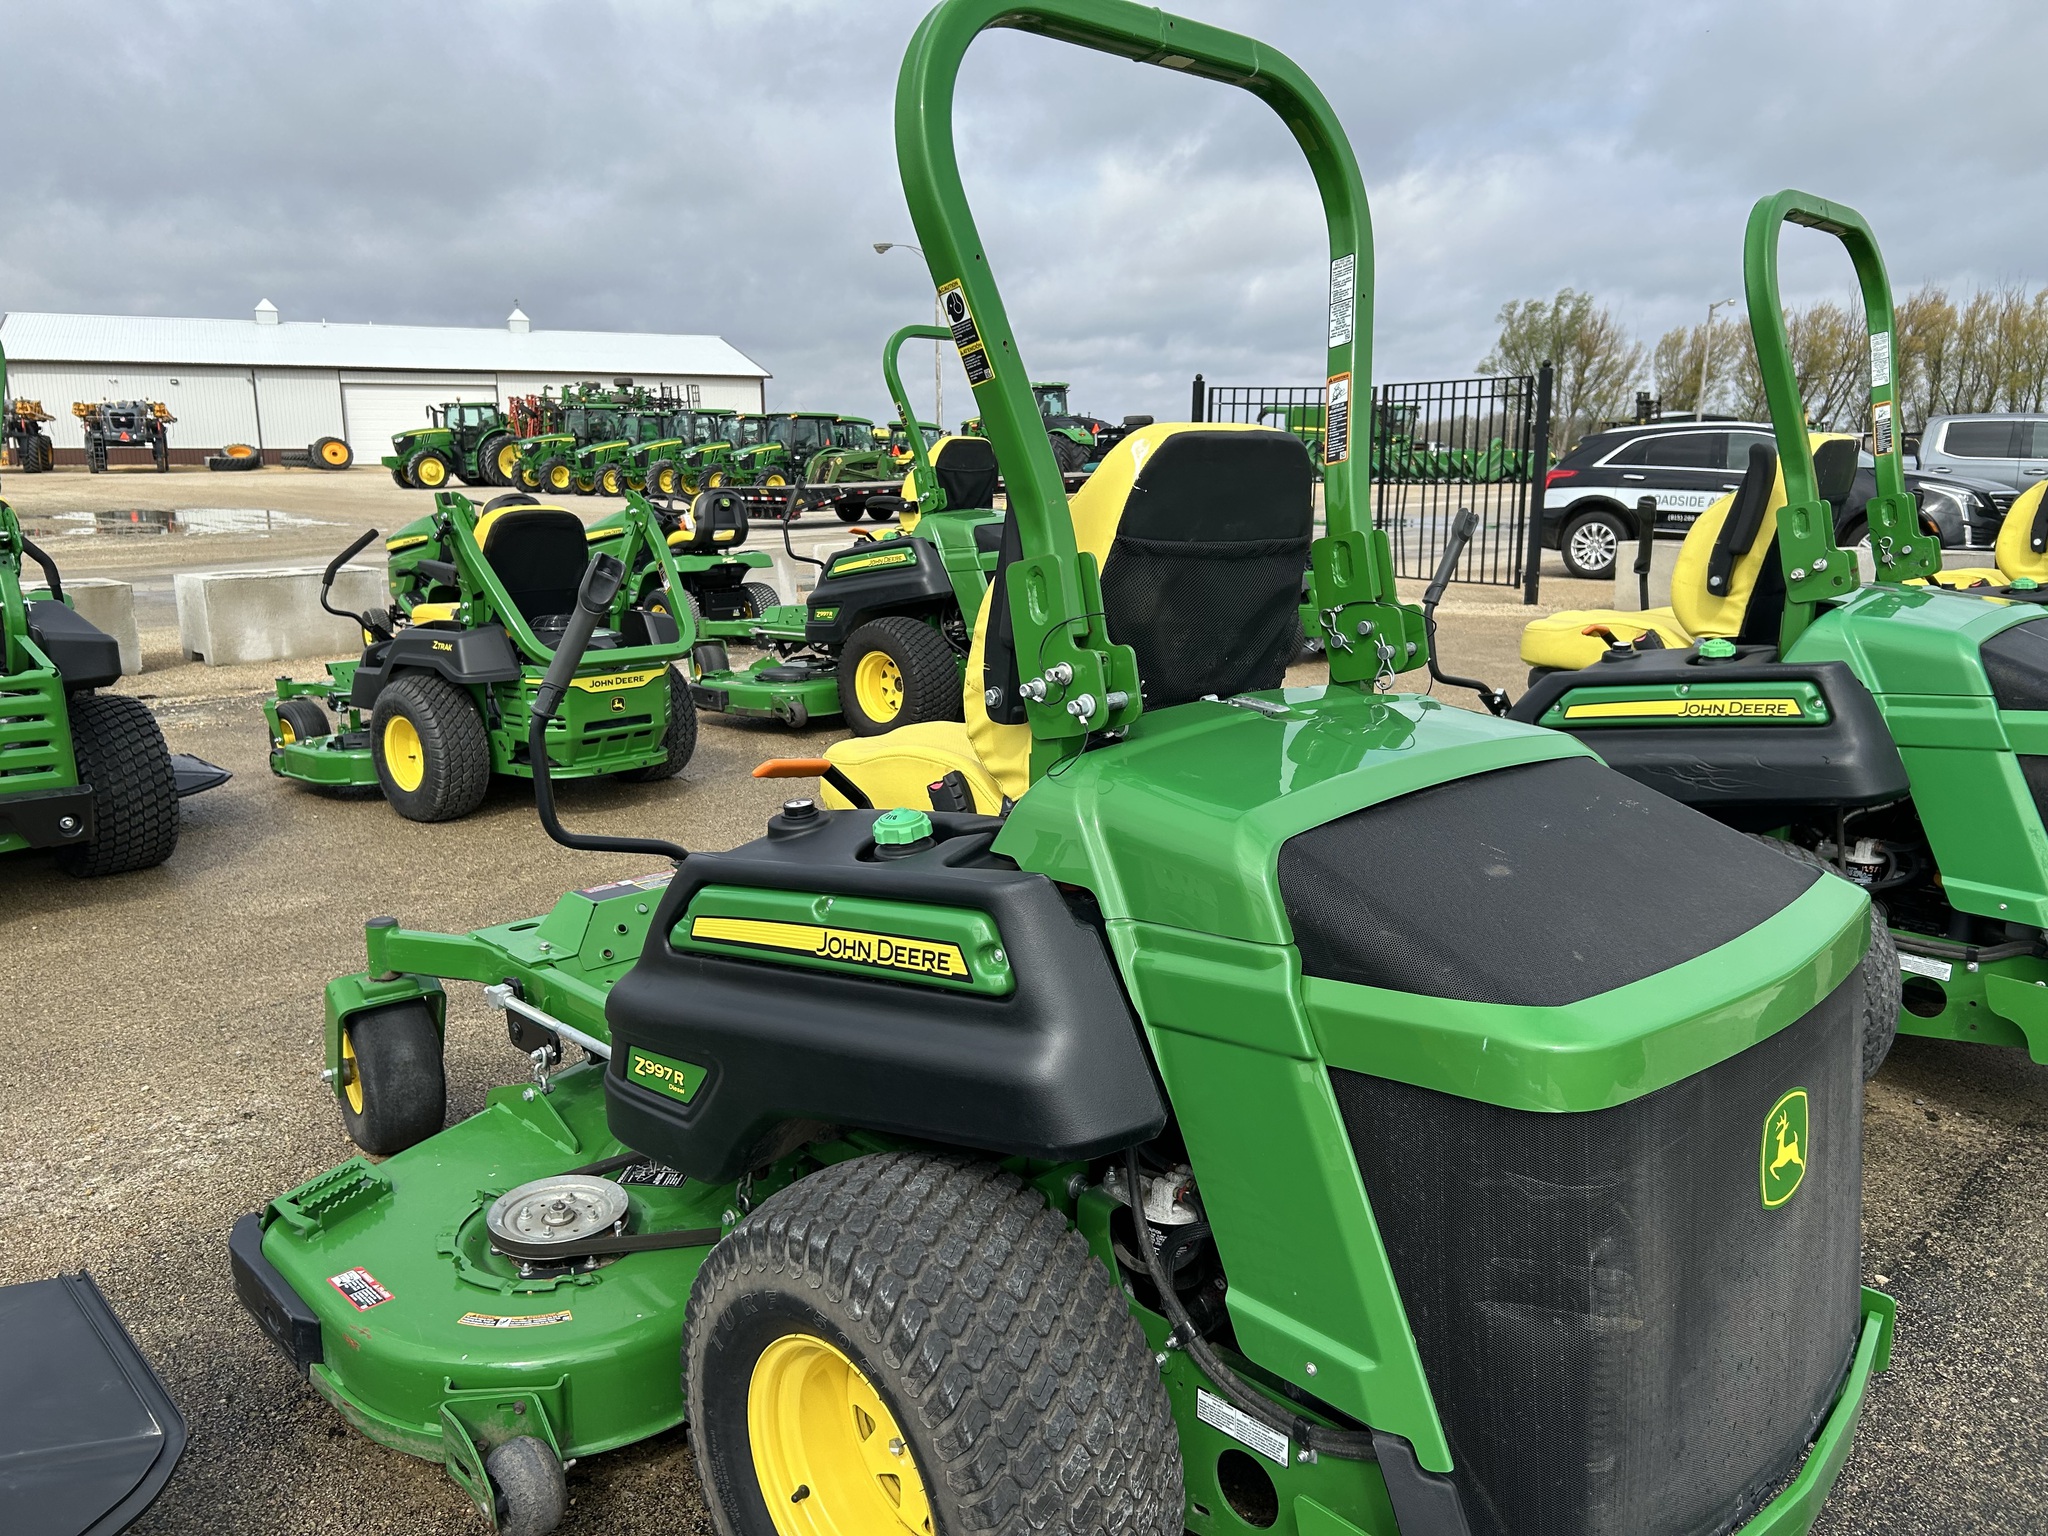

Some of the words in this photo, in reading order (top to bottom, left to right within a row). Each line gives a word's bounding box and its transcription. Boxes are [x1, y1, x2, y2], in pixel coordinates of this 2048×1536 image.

[1654, 494, 1706, 507] OADSIDE
[589, 679, 613, 688] JOHN
[615, 675, 645, 685] DEERE
[1678, 702, 1726, 717] JOHN
[1728, 701, 1788, 715] DEERE
[815, 932, 873, 961] JOHN
[877, 939, 951, 973] DEERE
[634, 1055, 685, 1086] Z997R
[668, 1083, 685, 1095] Diesel
